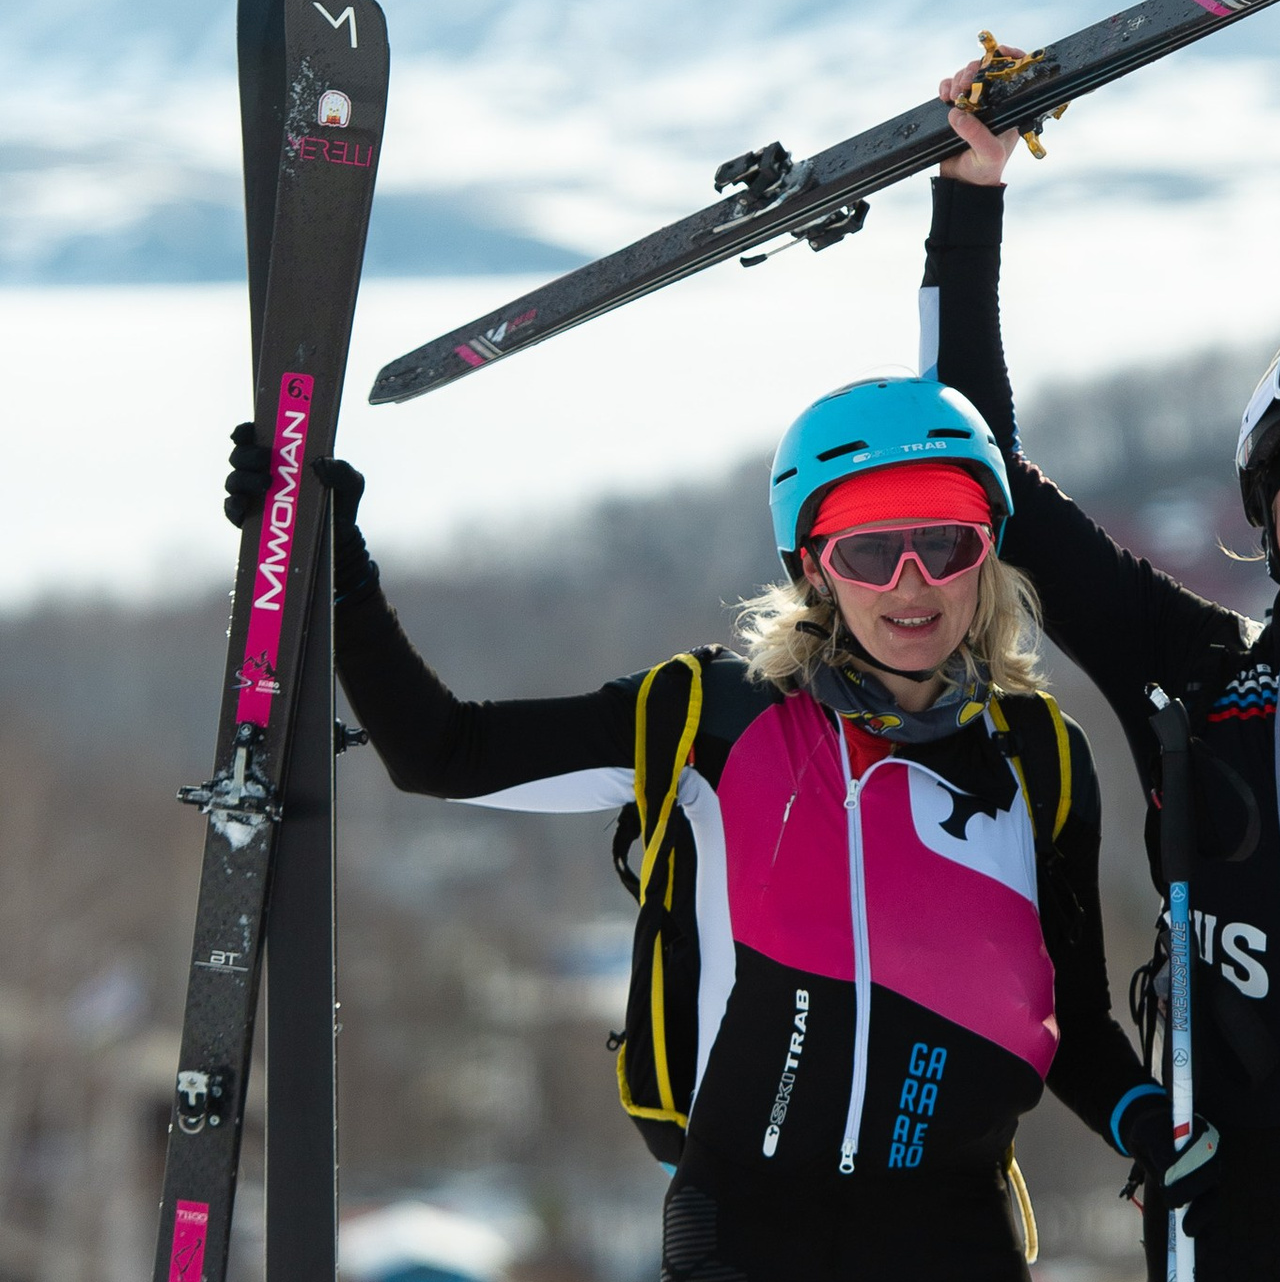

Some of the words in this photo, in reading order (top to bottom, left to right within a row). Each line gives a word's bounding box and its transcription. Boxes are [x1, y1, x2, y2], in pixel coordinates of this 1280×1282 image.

[253, 411, 307, 611] MWOMAN
[1171, 921, 1188, 1032] KREUZSPITZE
[770, 988, 809, 1125] SKITRAB
[909, 1042, 947, 1081] GA
[900, 1078, 938, 1116] RA
[893, 1115, 928, 1145] AE
[888, 1142, 923, 1168] RO
